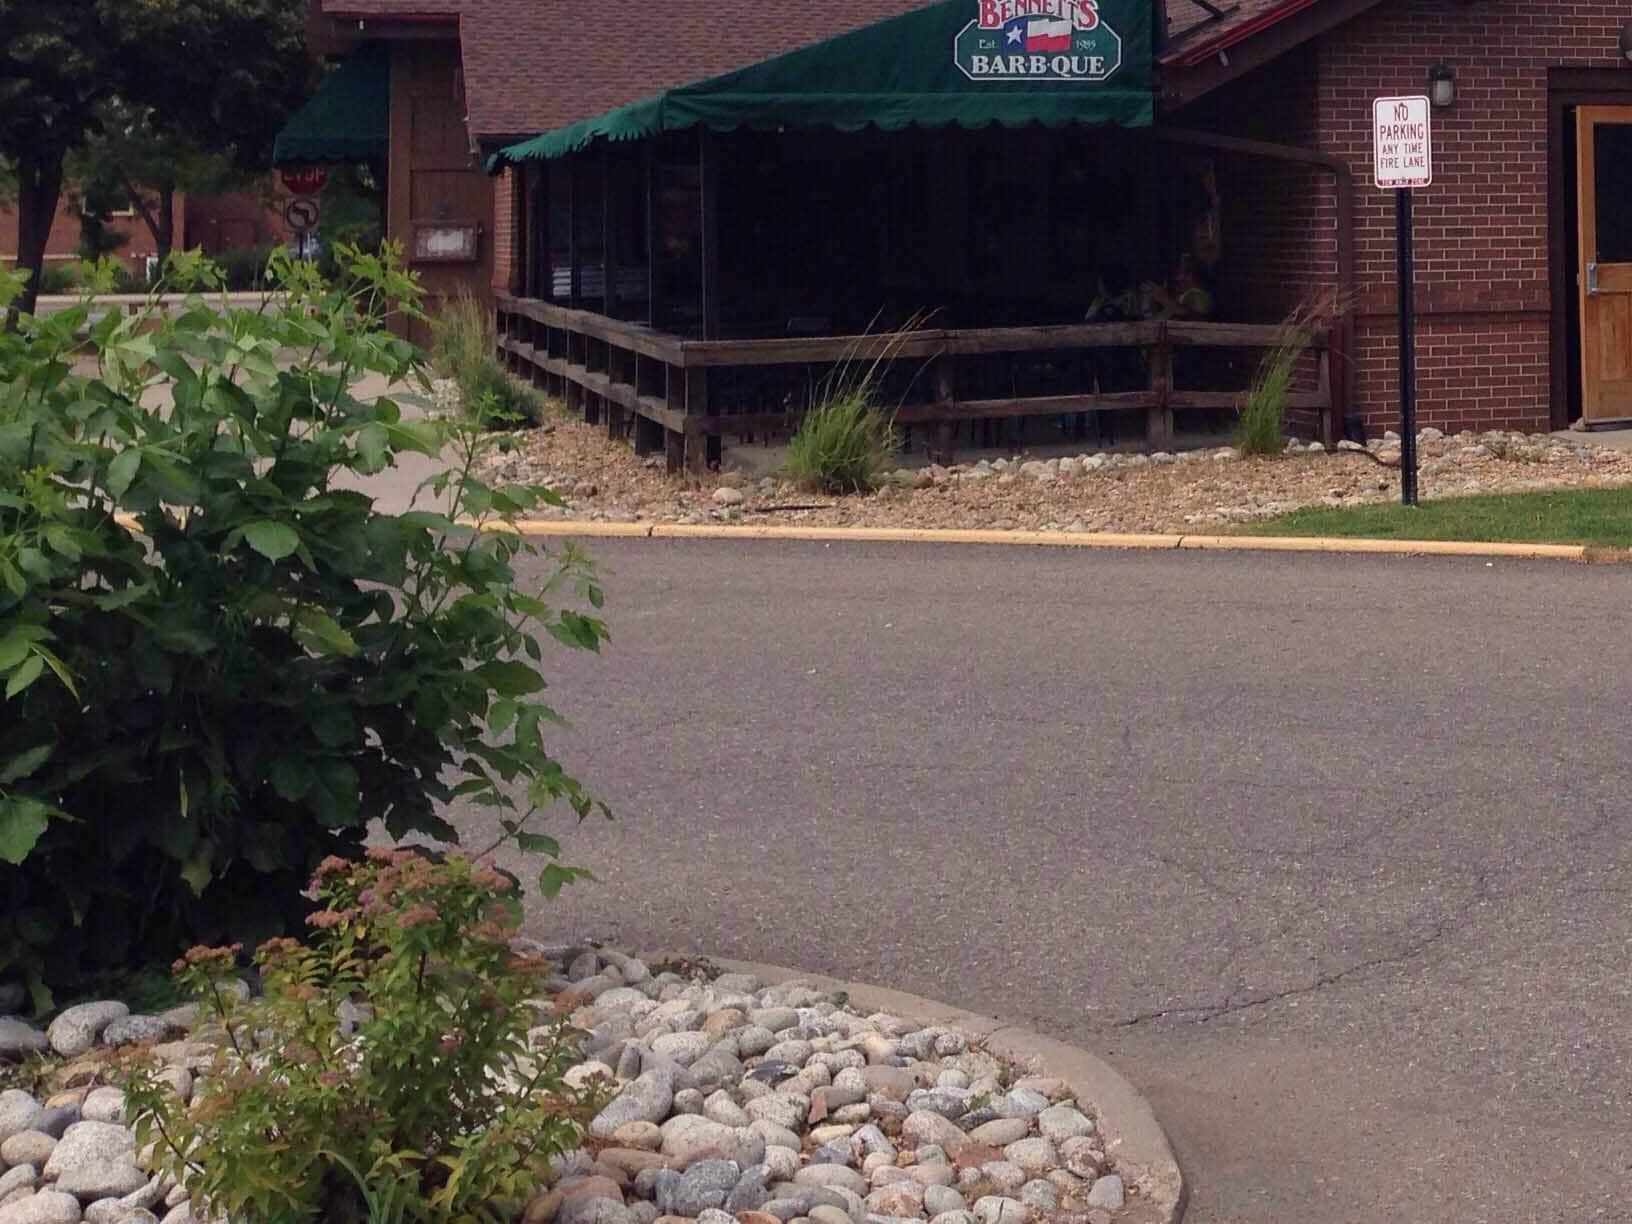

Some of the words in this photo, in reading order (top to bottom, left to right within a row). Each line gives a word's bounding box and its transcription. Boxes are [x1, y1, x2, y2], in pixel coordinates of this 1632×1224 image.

[1393, 104, 1409, 121] NO
[1380, 123, 1424, 141] PARKING
[1382, 143, 1399, 155] ANY
[1404, 142, 1423, 154] TIME
[1380, 157, 1399, 169] FIRE
[1403, 156, 1425, 168] LANE
